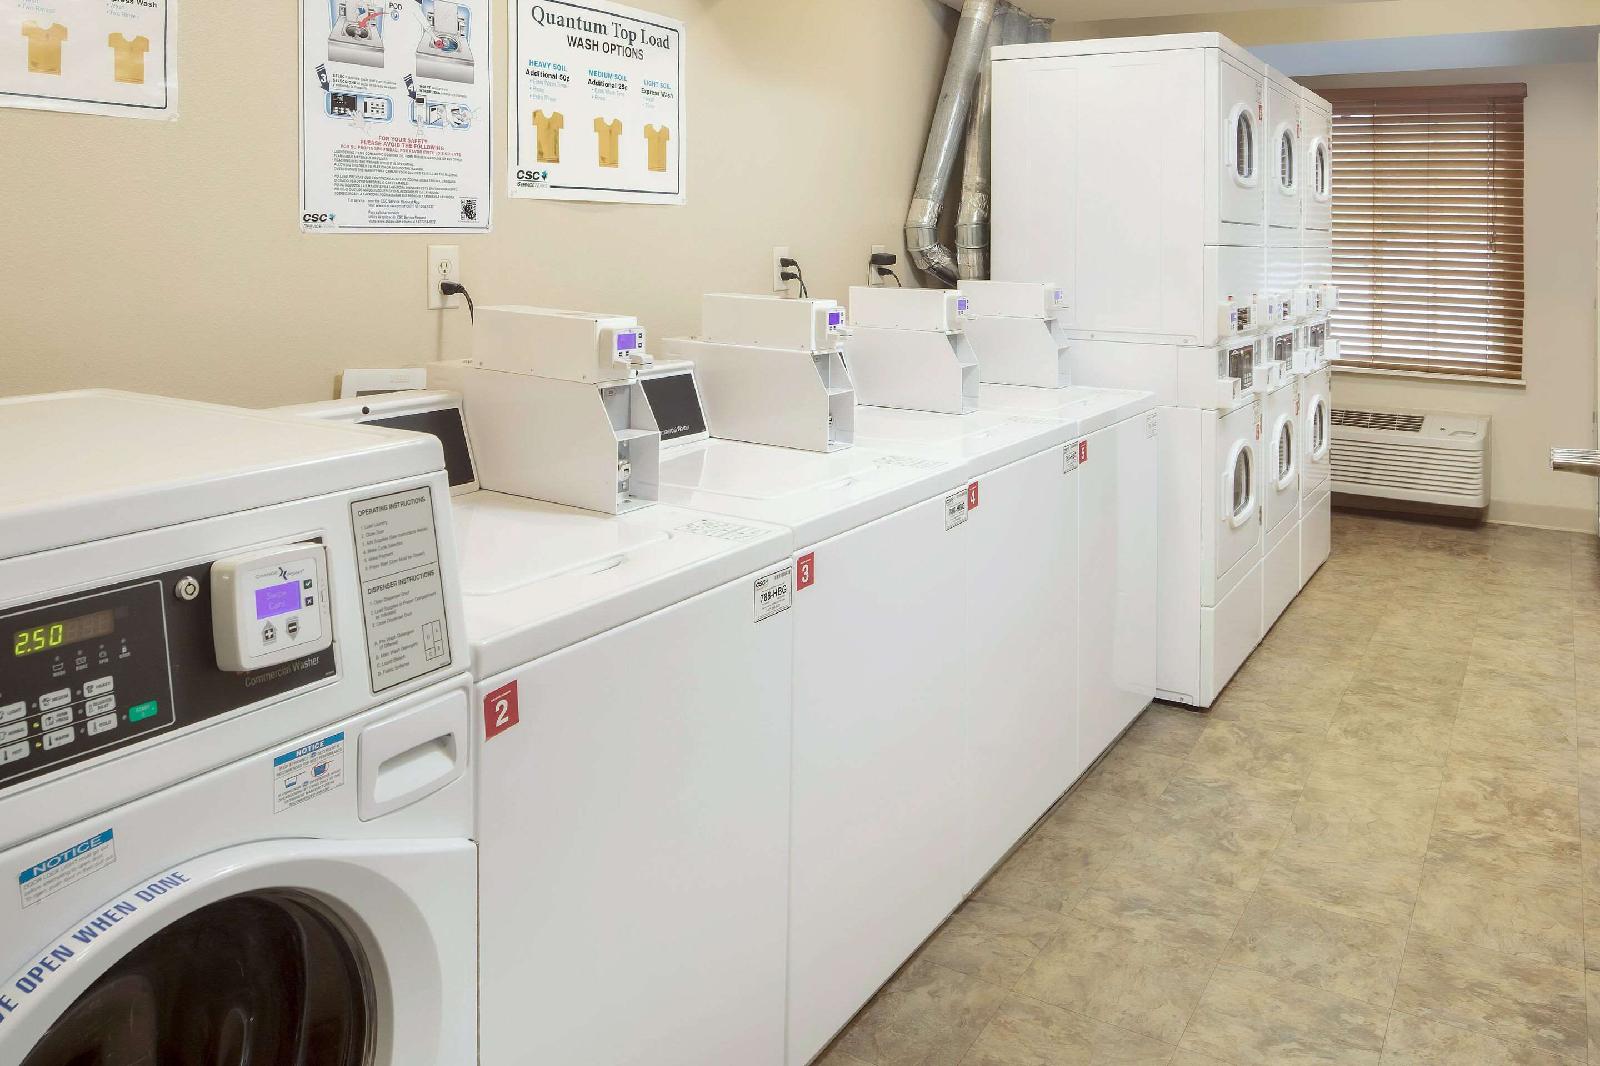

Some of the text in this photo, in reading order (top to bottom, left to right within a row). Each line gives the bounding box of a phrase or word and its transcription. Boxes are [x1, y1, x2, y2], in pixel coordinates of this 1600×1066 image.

[389, 2, 403, 10] POD
[531, 5, 670, 49] Quantum Top Load
[567, 34, 644, 60] WASH OPTIONS
[525, 68, 558, 80] Additional
[528, 59, 568, 72] HEAVY SOIL
[588, 69, 613, 80] MEDIUM
[587, 78, 617, 89] Additional
[516, 169, 540, 180] CSC
[303, 213, 328, 222] CSC
[357, 495, 426, 517] OPERATING INSTRUCTIONS
[367, 569, 435, 595] DISPENSER INSTRUCTIONS
[801, 564, 809, 583] 3
[14, 624, 64, 656] 2.50
[244, 656, 321, 688] Commercial Washer
[495, 699, 509, 728] 2
[295, 740, 325, 757] NOTICE
[32, 835, 103, 877] NOTICE
[15, 944, 75, 994] OPEN
[71, 900, 138, 944] WHEN
[134, 871, 191, 903] DONE
